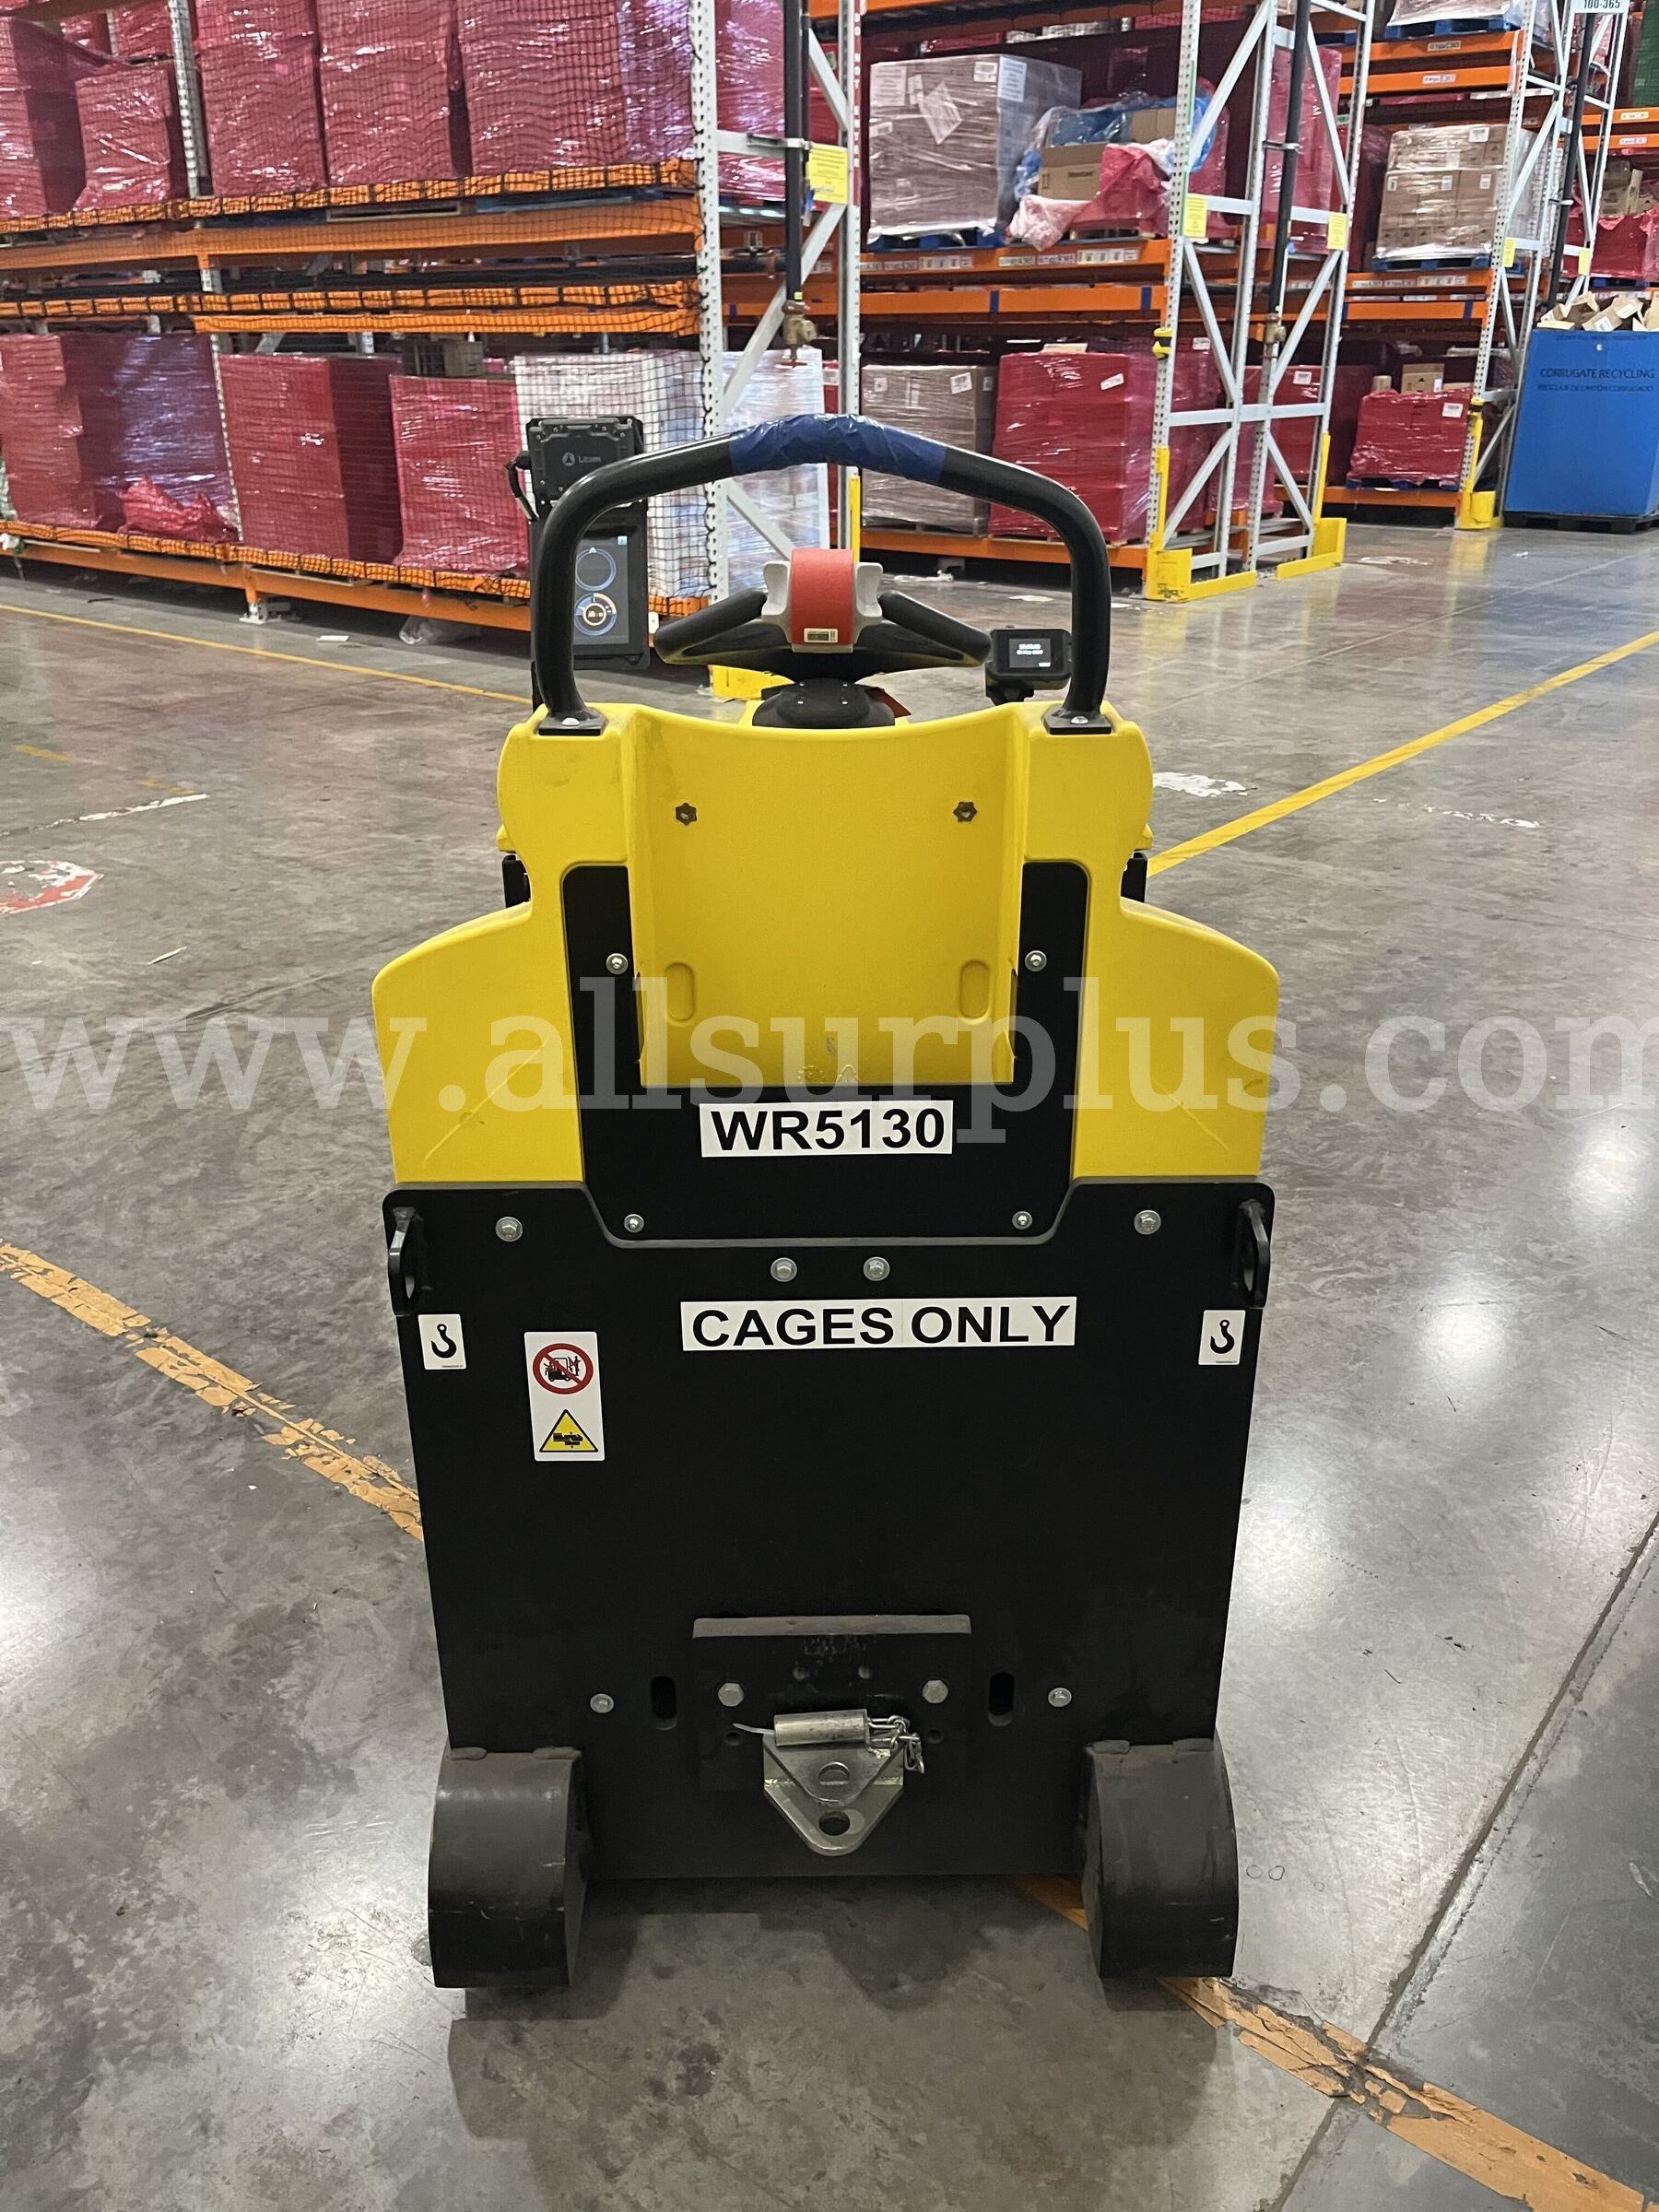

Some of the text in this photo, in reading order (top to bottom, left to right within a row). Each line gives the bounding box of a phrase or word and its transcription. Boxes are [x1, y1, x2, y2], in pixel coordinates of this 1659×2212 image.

[1583, 0, 1620, 9] 100-365
[1540, 368, 1655, 379] CORRUGATE RECYCLING
[711, 1108, 945, 1151] WR5130
[692, 1305, 1070, 1347] CAGES ONLY
